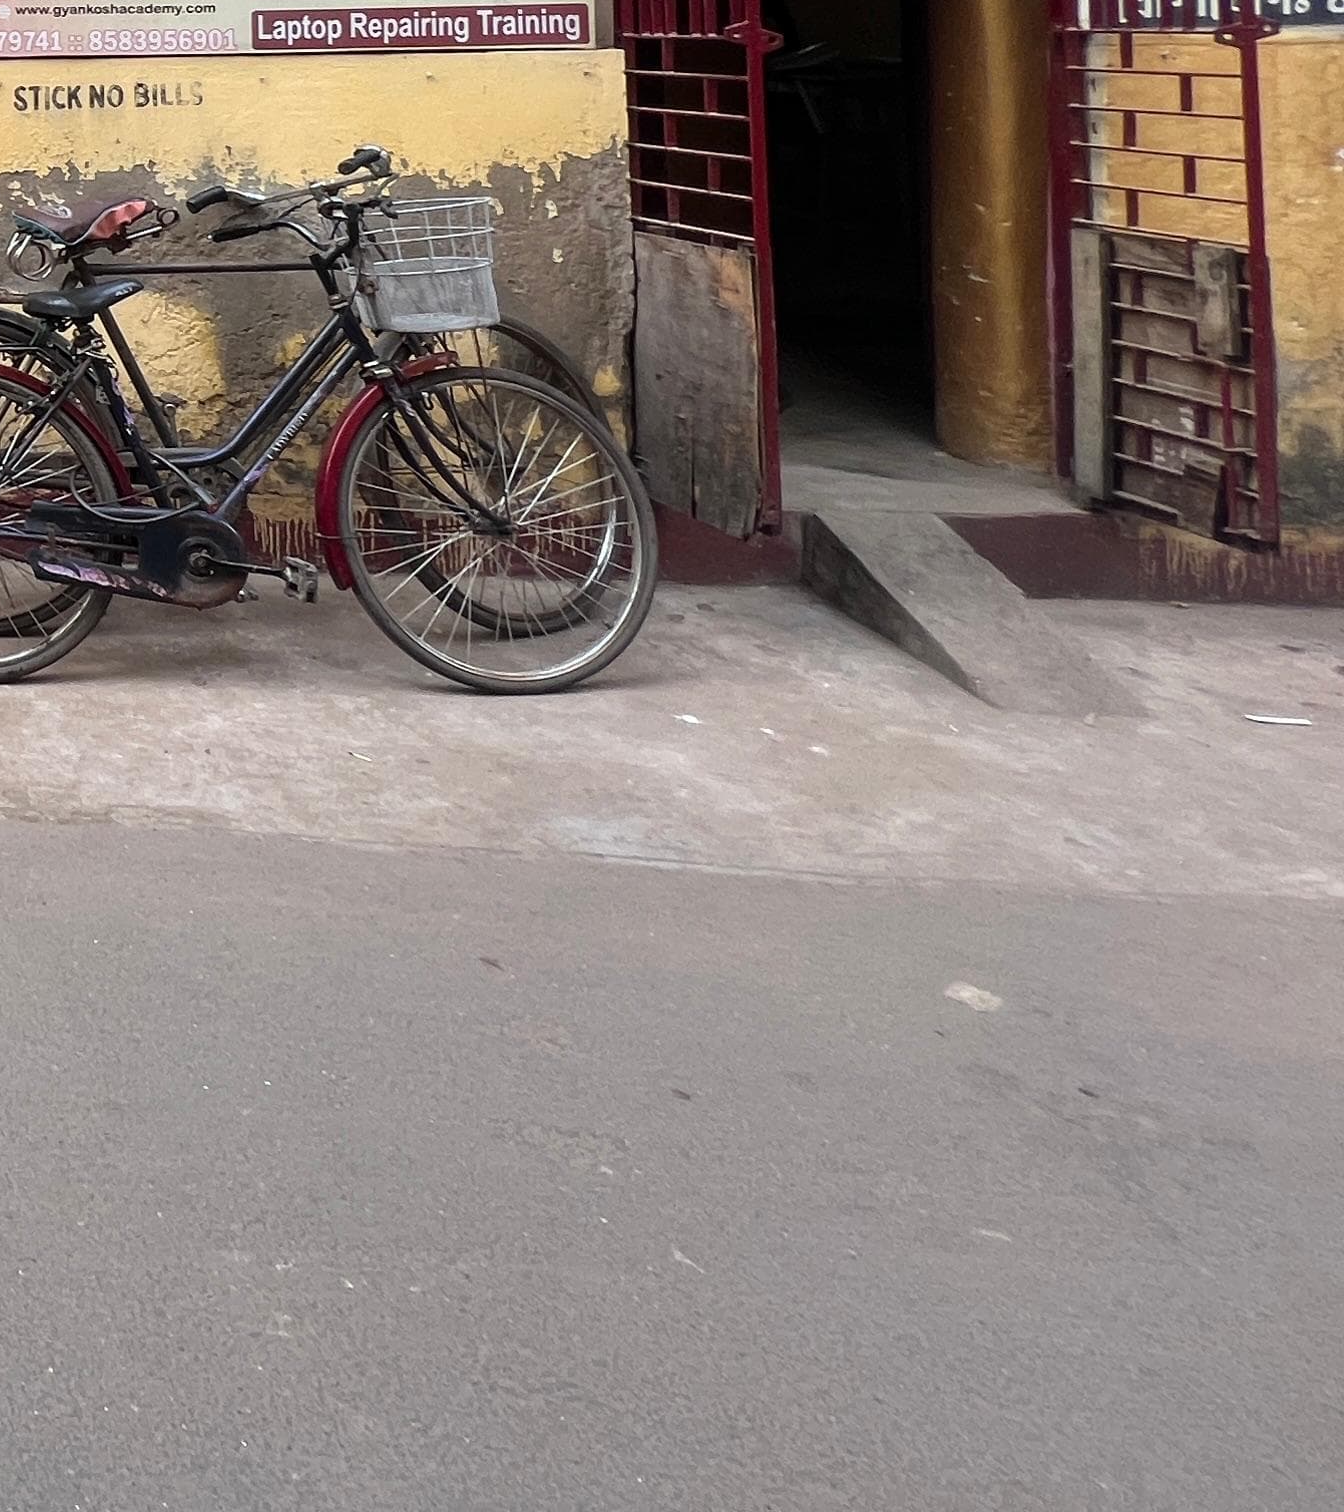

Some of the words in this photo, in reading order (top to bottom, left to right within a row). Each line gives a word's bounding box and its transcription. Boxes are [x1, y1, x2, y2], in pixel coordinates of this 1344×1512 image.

[15, 4, 216, 18] www.gyankoshacademy.com
[88, 28, 238, 51] 8583956901
[256, 14, 342, 46] Laptop
[349, 11, 470, 43] Repairing
[476, 8, 581, 40] Training
[13, 84, 82, 111] STICK
[88, 83, 123, 108] NO
[134, 81, 204, 107] BILLS
